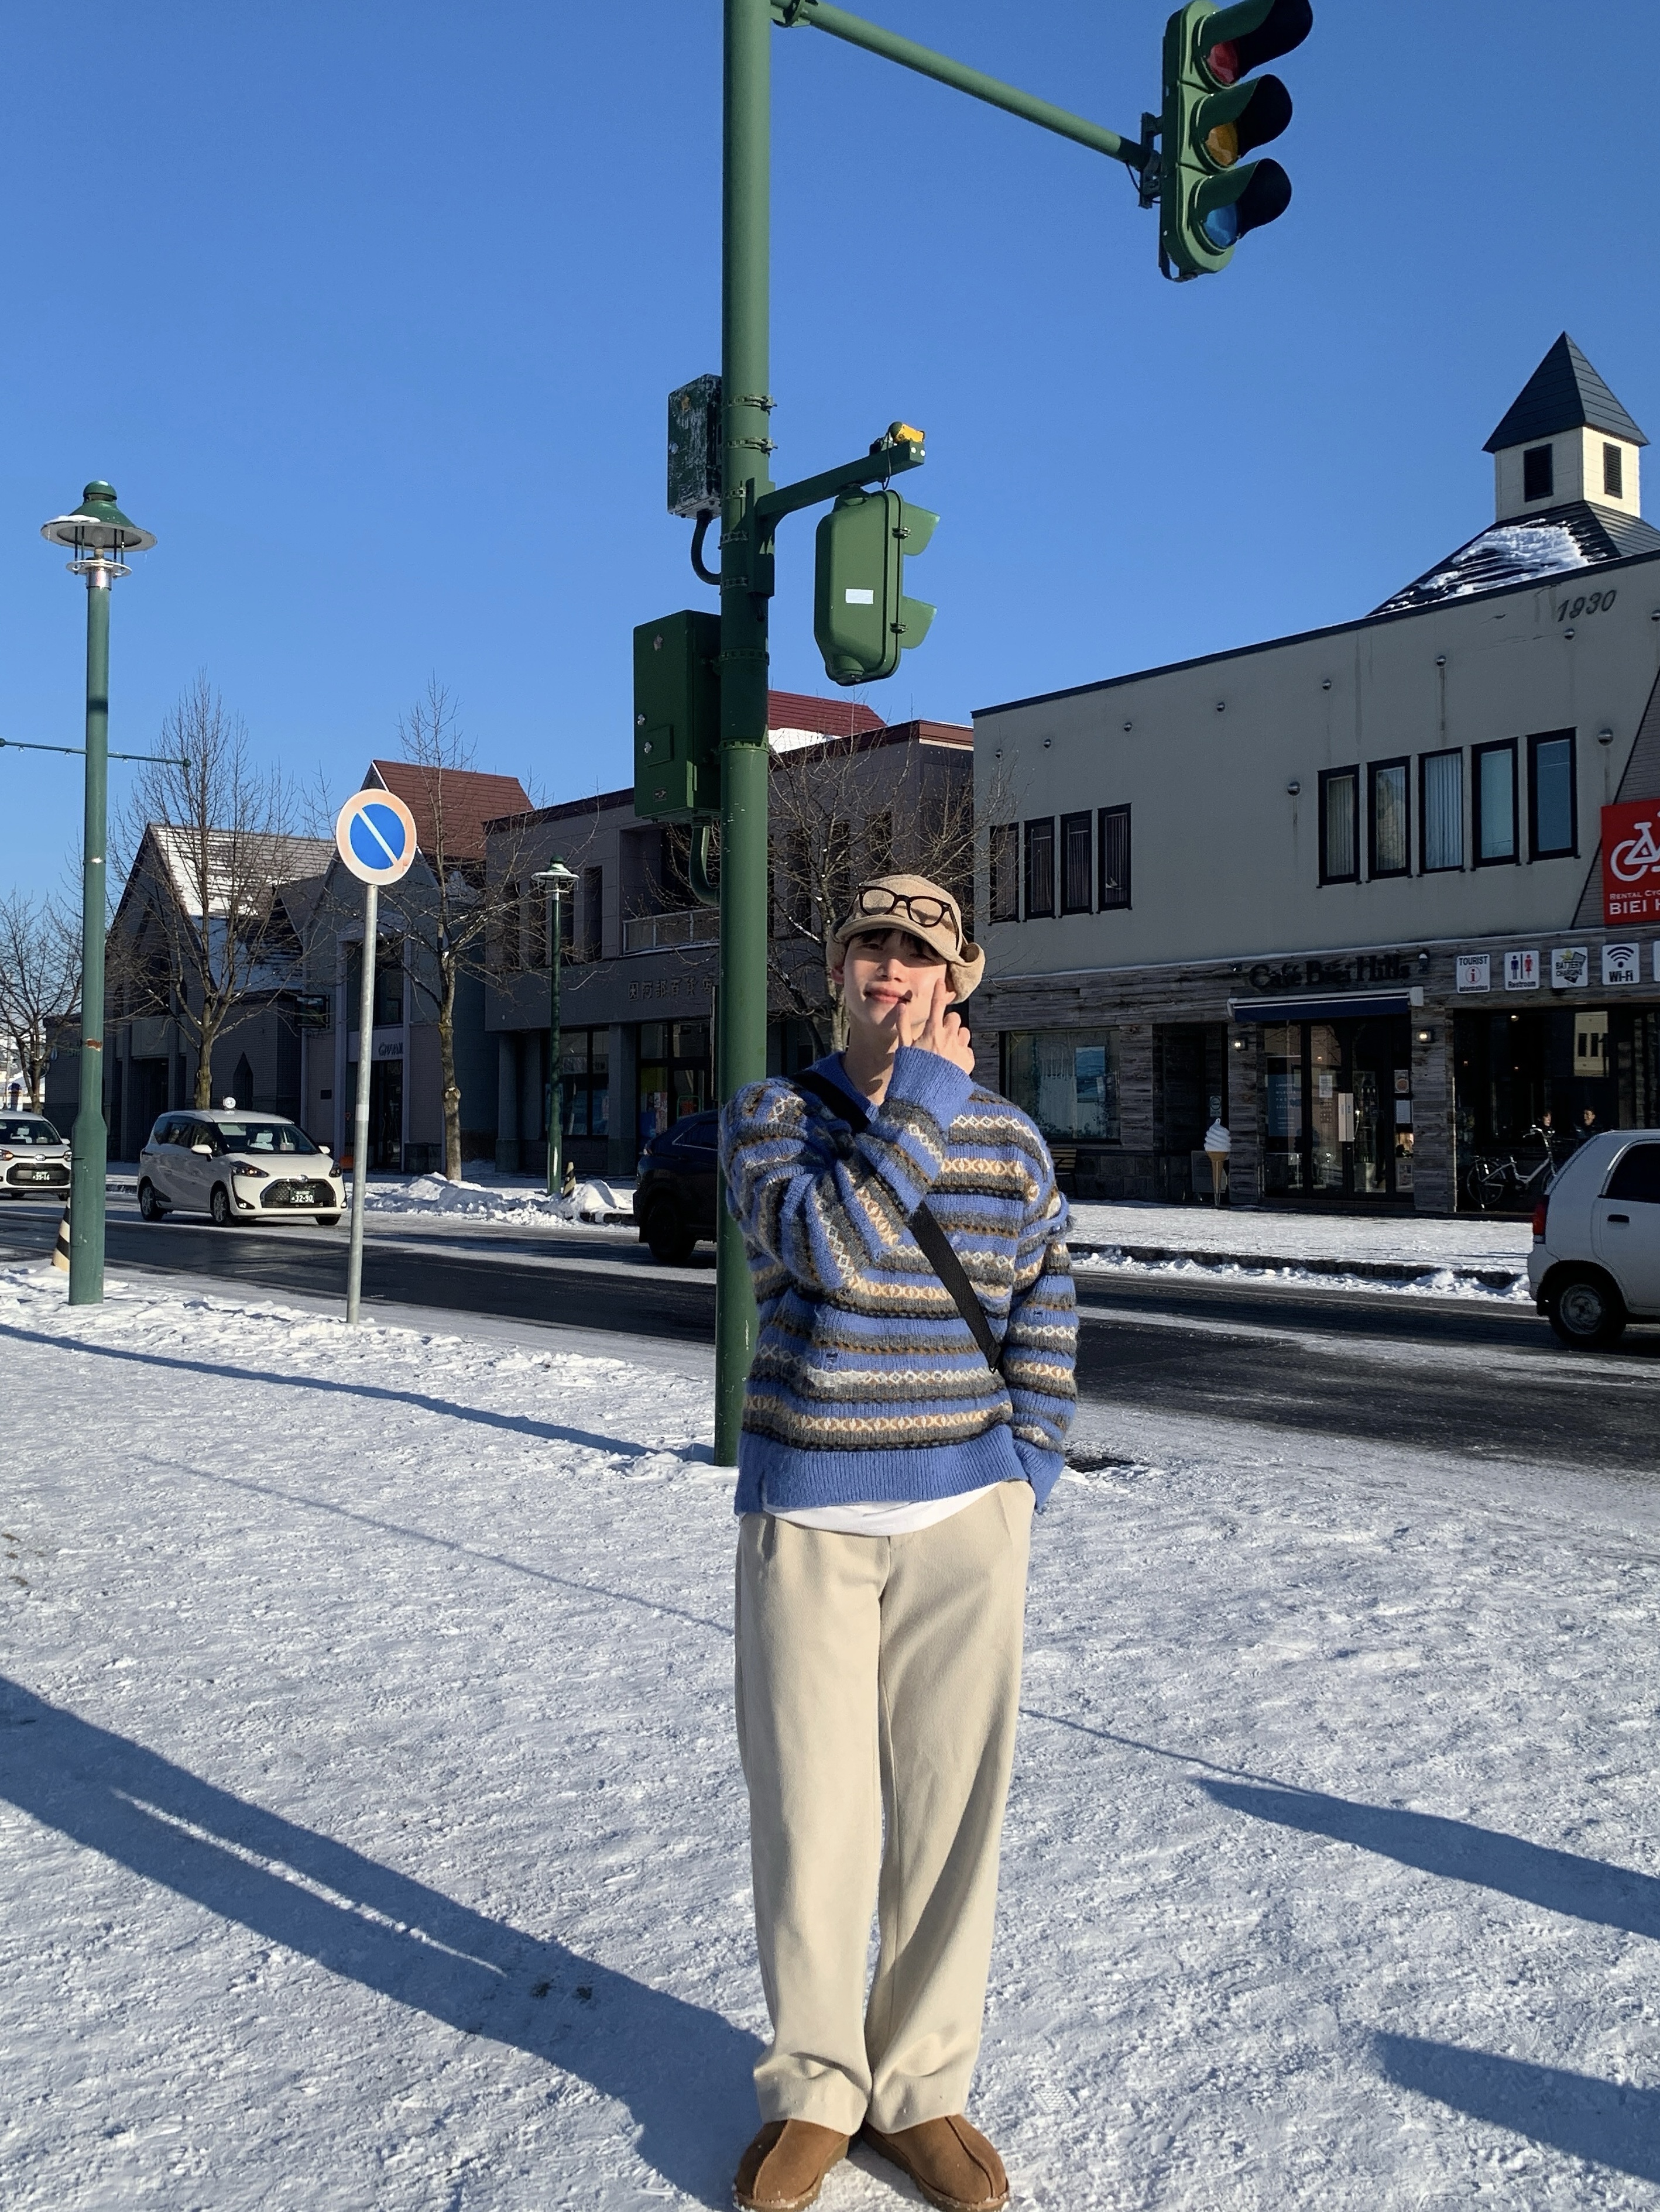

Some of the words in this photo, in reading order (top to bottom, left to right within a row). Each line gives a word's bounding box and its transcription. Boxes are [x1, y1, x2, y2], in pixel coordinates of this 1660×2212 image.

[1557, 589, 1617, 622] 1930
[1610, 892, 1643, 900] RENTAL
[1609, 899, 1647, 915] BIEI
[1459, 956, 1488, 966] TOURIST
[1305, 960, 1352, 985] Biei
[1355, 954, 1411, 981] Hills
[1608, 970, 1634, 983] Wi-Fi
